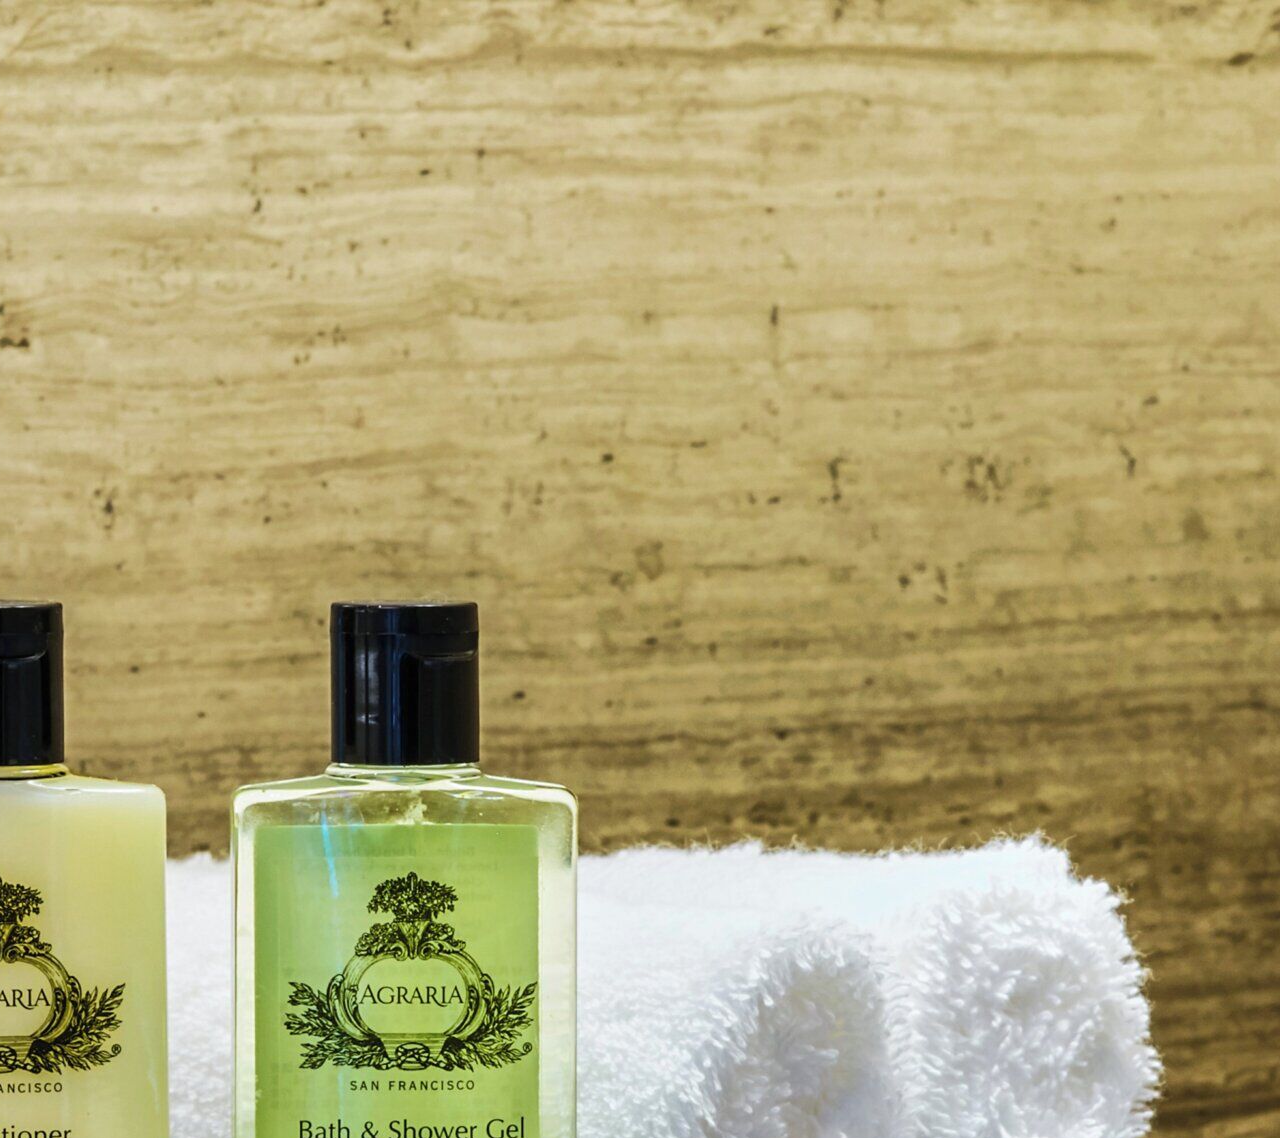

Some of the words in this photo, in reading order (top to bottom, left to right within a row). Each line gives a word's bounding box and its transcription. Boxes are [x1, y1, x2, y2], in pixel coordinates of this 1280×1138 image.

[358, 983, 464, 1007] AGRARIA
[350, 1080, 380, 1091] SAN
[388, 1079, 475, 1091] FRANCISCO
